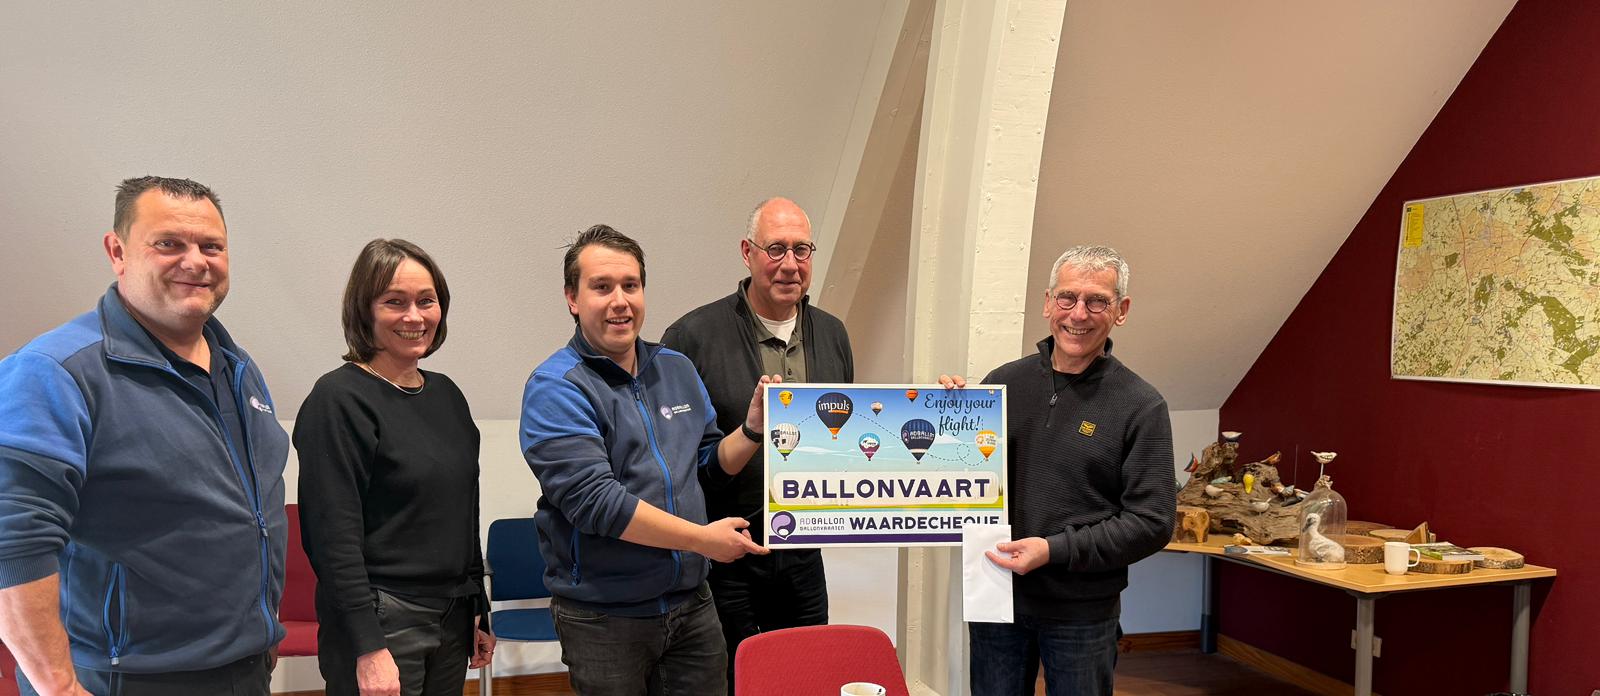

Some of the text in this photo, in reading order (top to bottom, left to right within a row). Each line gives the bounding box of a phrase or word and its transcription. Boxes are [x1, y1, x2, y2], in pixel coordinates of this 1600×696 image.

[818, 400, 850, 413] impuls
[925, 393, 996, 413] Enjoy your
[938, 416, 980, 436] flight!
[782, 479, 990, 499] BALLONVAART
[800, 517, 844, 525] ADBALLON
